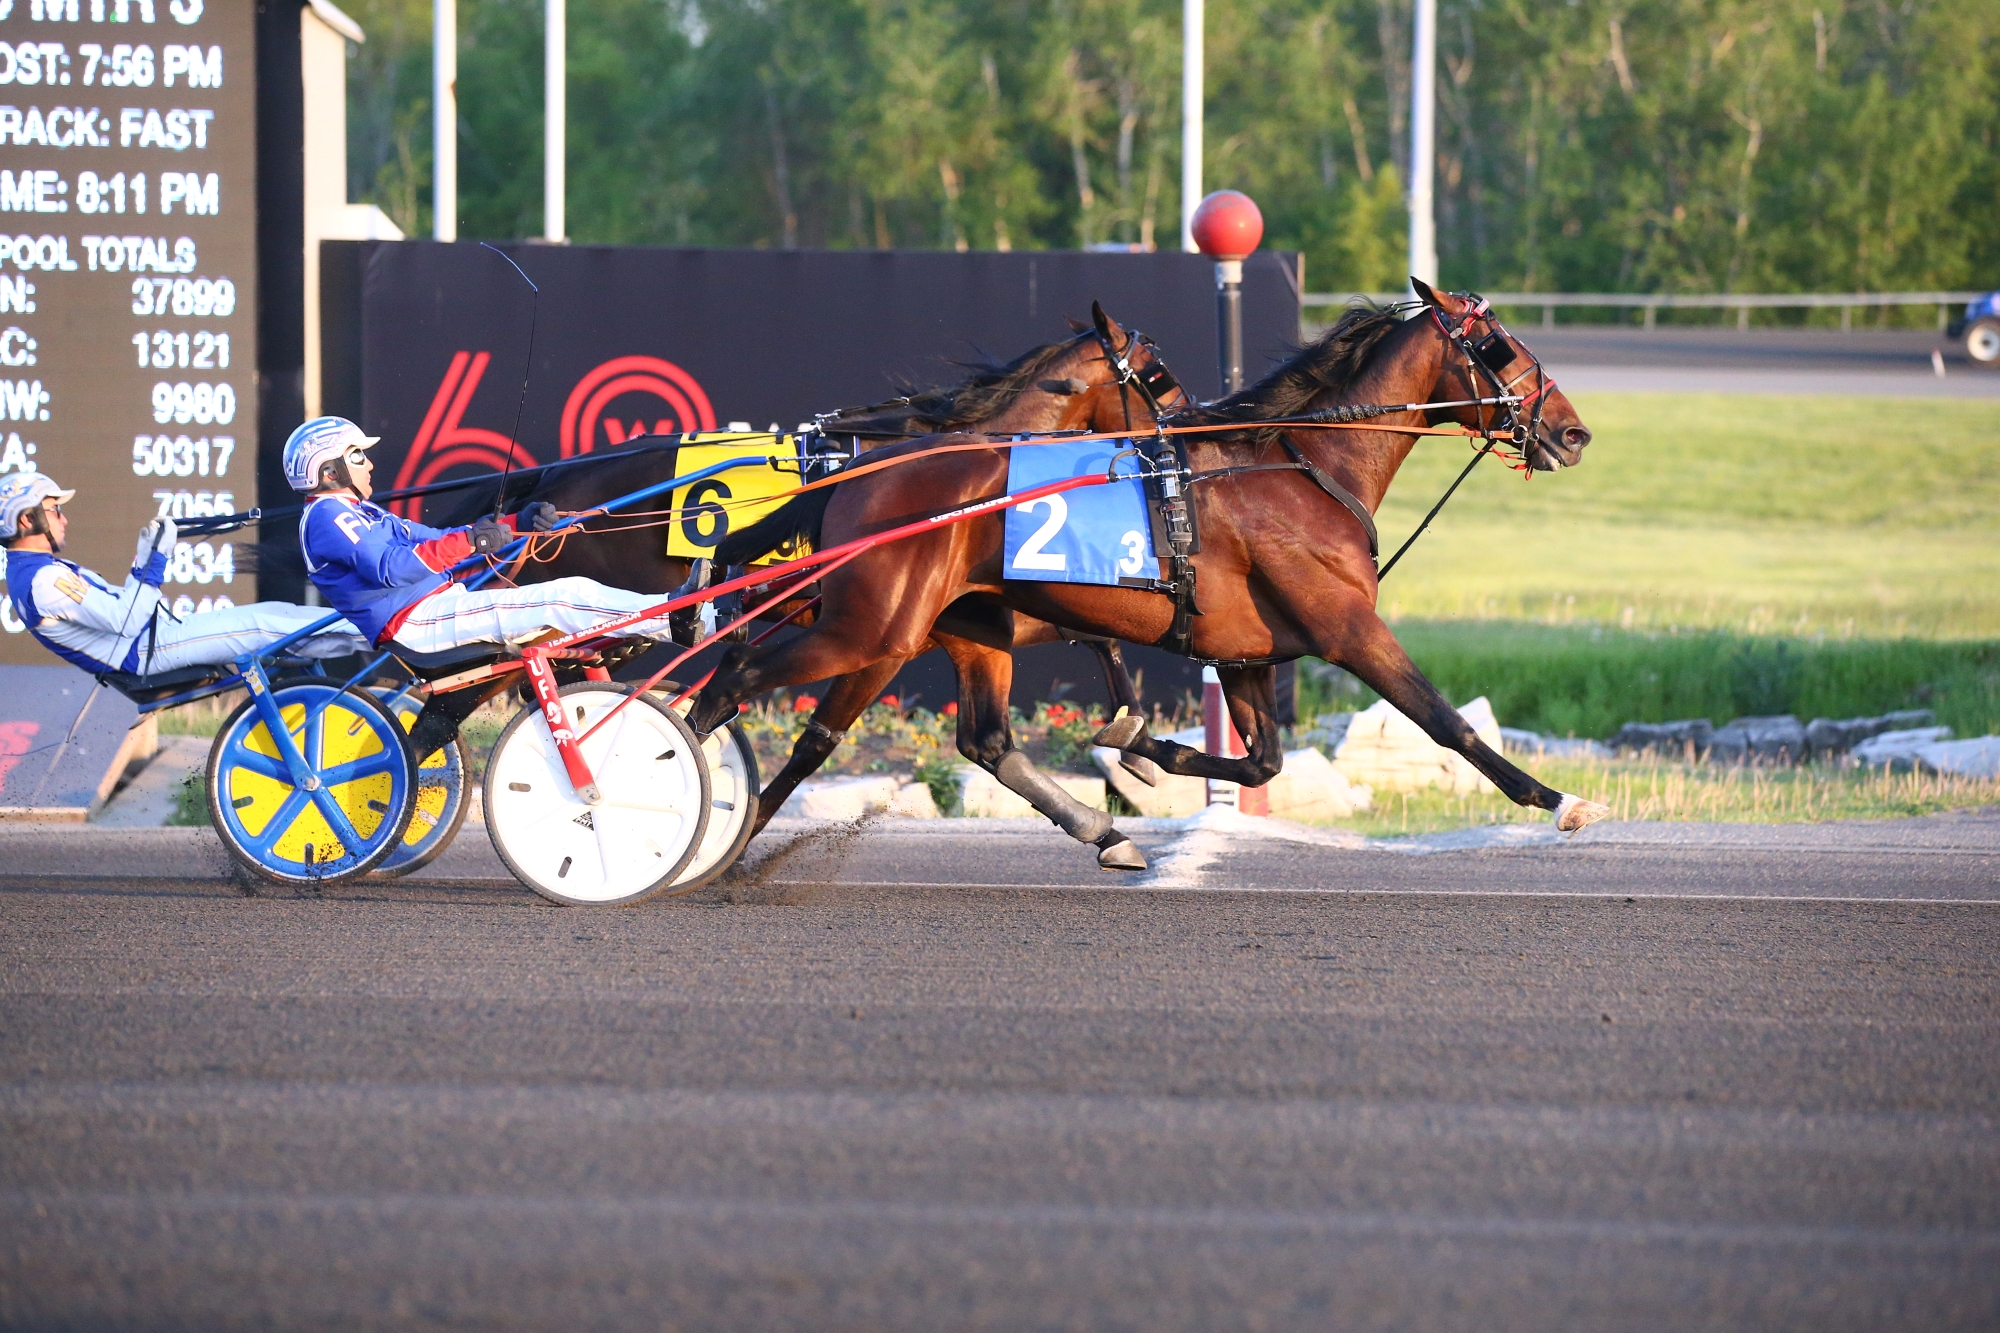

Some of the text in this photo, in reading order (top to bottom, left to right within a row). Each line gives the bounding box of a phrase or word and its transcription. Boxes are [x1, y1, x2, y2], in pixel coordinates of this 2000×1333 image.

[79, 44, 154, 87] 7:56
[163, 45, 222, 88] PM
[120, 107, 214, 150] FAST
[76, 171, 146, 214] 8:11
[160, 172, 219, 215] PM
[0, 235, 197, 273] POOL TOTALS
[132, 276, 236, 317] 37899
[132, 330, 230, 369] 13121
[152, 381, 236, 425] 9980
[132, 435, 236, 477] 50317
[680, 478, 733, 548] 6
[1012, 492, 1068, 571] 2
[1119, 530, 1146, 575] 3
